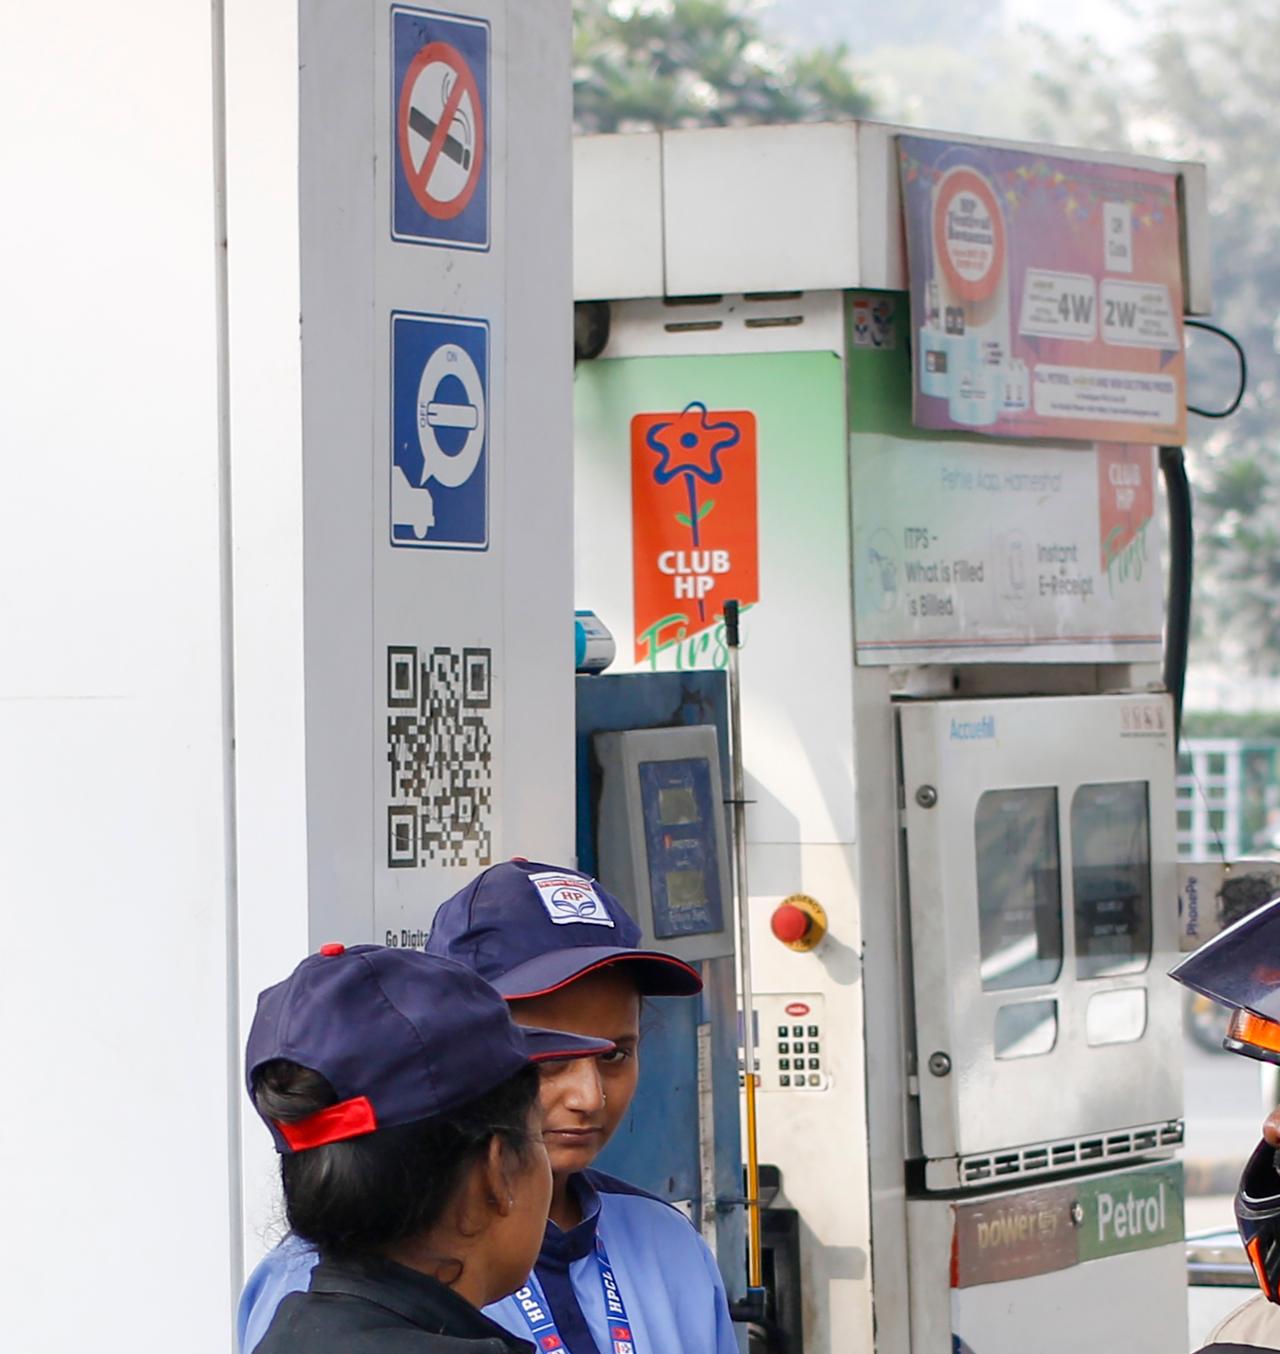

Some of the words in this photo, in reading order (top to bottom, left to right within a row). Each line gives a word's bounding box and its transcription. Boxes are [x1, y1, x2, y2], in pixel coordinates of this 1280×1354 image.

[1058, 293, 1093, 325] 4W
[1105, 299, 1136, 328] 2W
[657, 549, 731, 575] CLUB
[674, 575, 715, 600] HP
[561, 891, 584, 901] HP
[386, 930, 398, 947] Go
[401, 929, 429, 950] Digita
[1097, 1183, 1165, 1242] Petrol
[516, 1286, 545, 1323] HPC
[602, 1271, 623, 1313] HPCL
